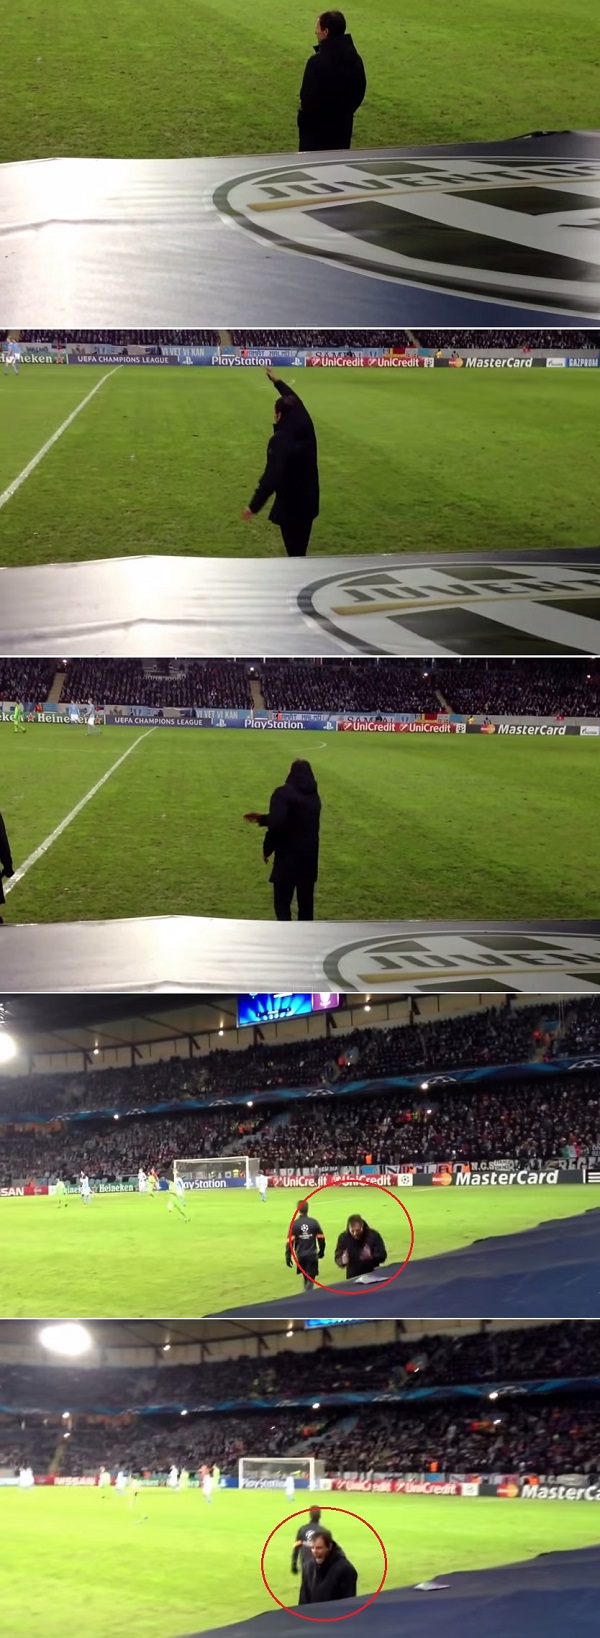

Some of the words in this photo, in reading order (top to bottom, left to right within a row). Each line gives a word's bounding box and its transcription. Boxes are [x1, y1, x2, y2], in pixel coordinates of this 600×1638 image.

[0, 353, 53, 363] Hneken
[98, 355, 140, 363] CHAMPIONS
[211, 356, 272, 366] PlayStation
[321, 357, 364, 367] UniCredit
[377, 357, 420, 367] UniCredit
[465, 357, 533, 368] MasterCard
[134, 717, 175, 725] CHAMPIONS
[176, 718, 203, 726] LEAGUE
[244, 719, 304, 730] PlayStation
[353, 721, 396, 732] UniCredit
[409, 722, 451, 733] UniCredit
[498, 724, 567, 735] MasterCard
[455, 1169, 560, 1186] MasterCard
[98, 1183, 134, 1193] Heineken
[182, 1179, 227, 1189] ayStation
